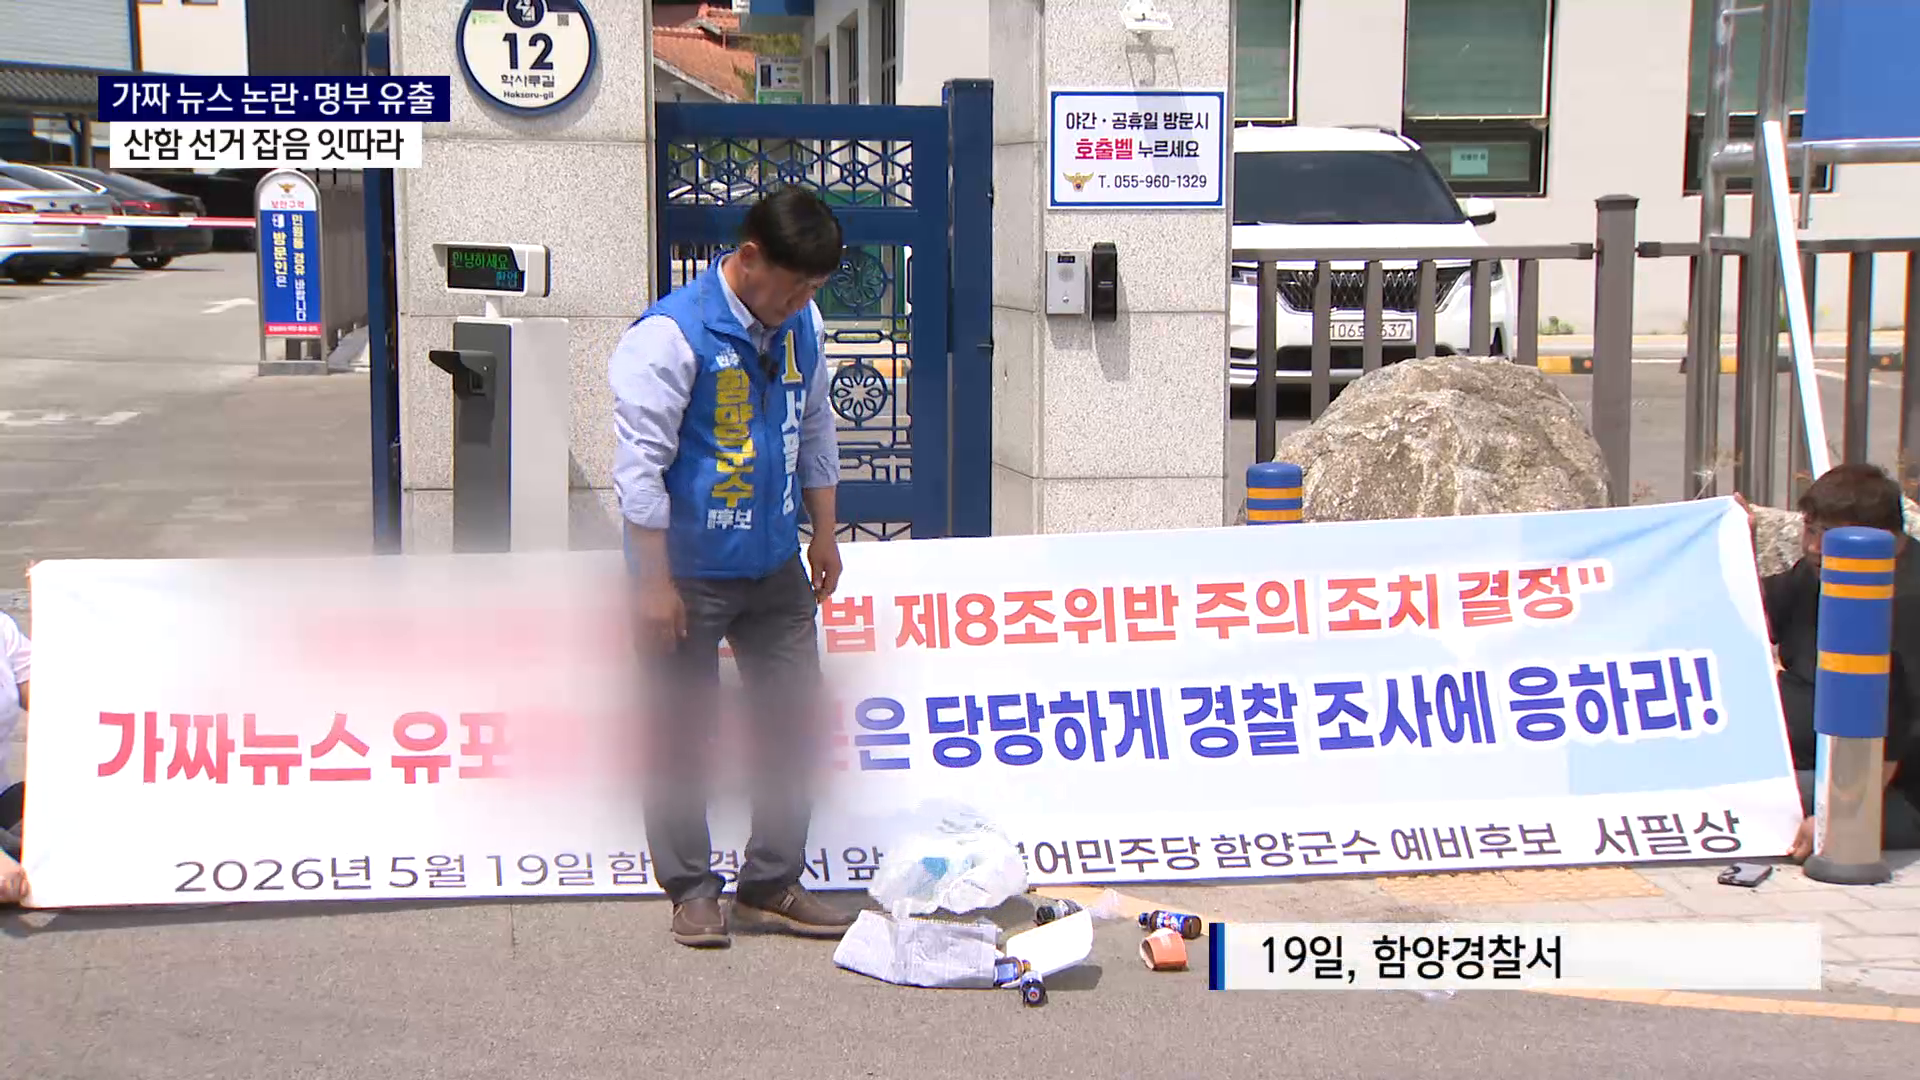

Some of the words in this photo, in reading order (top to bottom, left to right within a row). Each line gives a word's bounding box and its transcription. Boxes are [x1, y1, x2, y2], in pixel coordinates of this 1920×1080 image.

[502, 32, 554, 71] 12
[501, 74, 555, 88] 학사루길
[503, 90, 554, 100] Haksaru-gil
[1066, 112, 1098, 130] 야간
[1111, 111, 1158, 130] 공휴일
[1163, 111, 1209, 130] 방문시
[1074, 137, 1133, 160] 호출벨
[1138, 140, 1200, 158] 누르세요
[1098, 175, 1111, 188] T.
[1114, 174, 1207, 189] 055-960-1329
[452, 252, 508, 270] 안녕하세요
[781, 329, 803, 384] 1
[711, 367, 756, 508] 함양군수
[895, 584, 1179, 649] 제8조위반
[1195, 579, 1309, 640] 주의
[1327, 573, 1440, 631] 조치
[97, 710, 372, 786] 가짜뉴스
[926, 686, 1170, 768] 당당하게
[1181, 683, 1299, 759] 경찰
[1315, 671, 1495, 750] 조사에
[1509, 656, 1719, 741] 응하라!
[175, 856, 372, 893] 2026년
[389, 855, 467, 889] 5월
[484, 849, 594, 888] 19일
[608, 844, 830, 887] 함경서
[842, 845, 884, 882] 앞
[1209, 827, 1381, 870] 함양군수
[1390, 822, 1562, 863] 예비후보
[1593, 809, 1743, 858] 서필상
